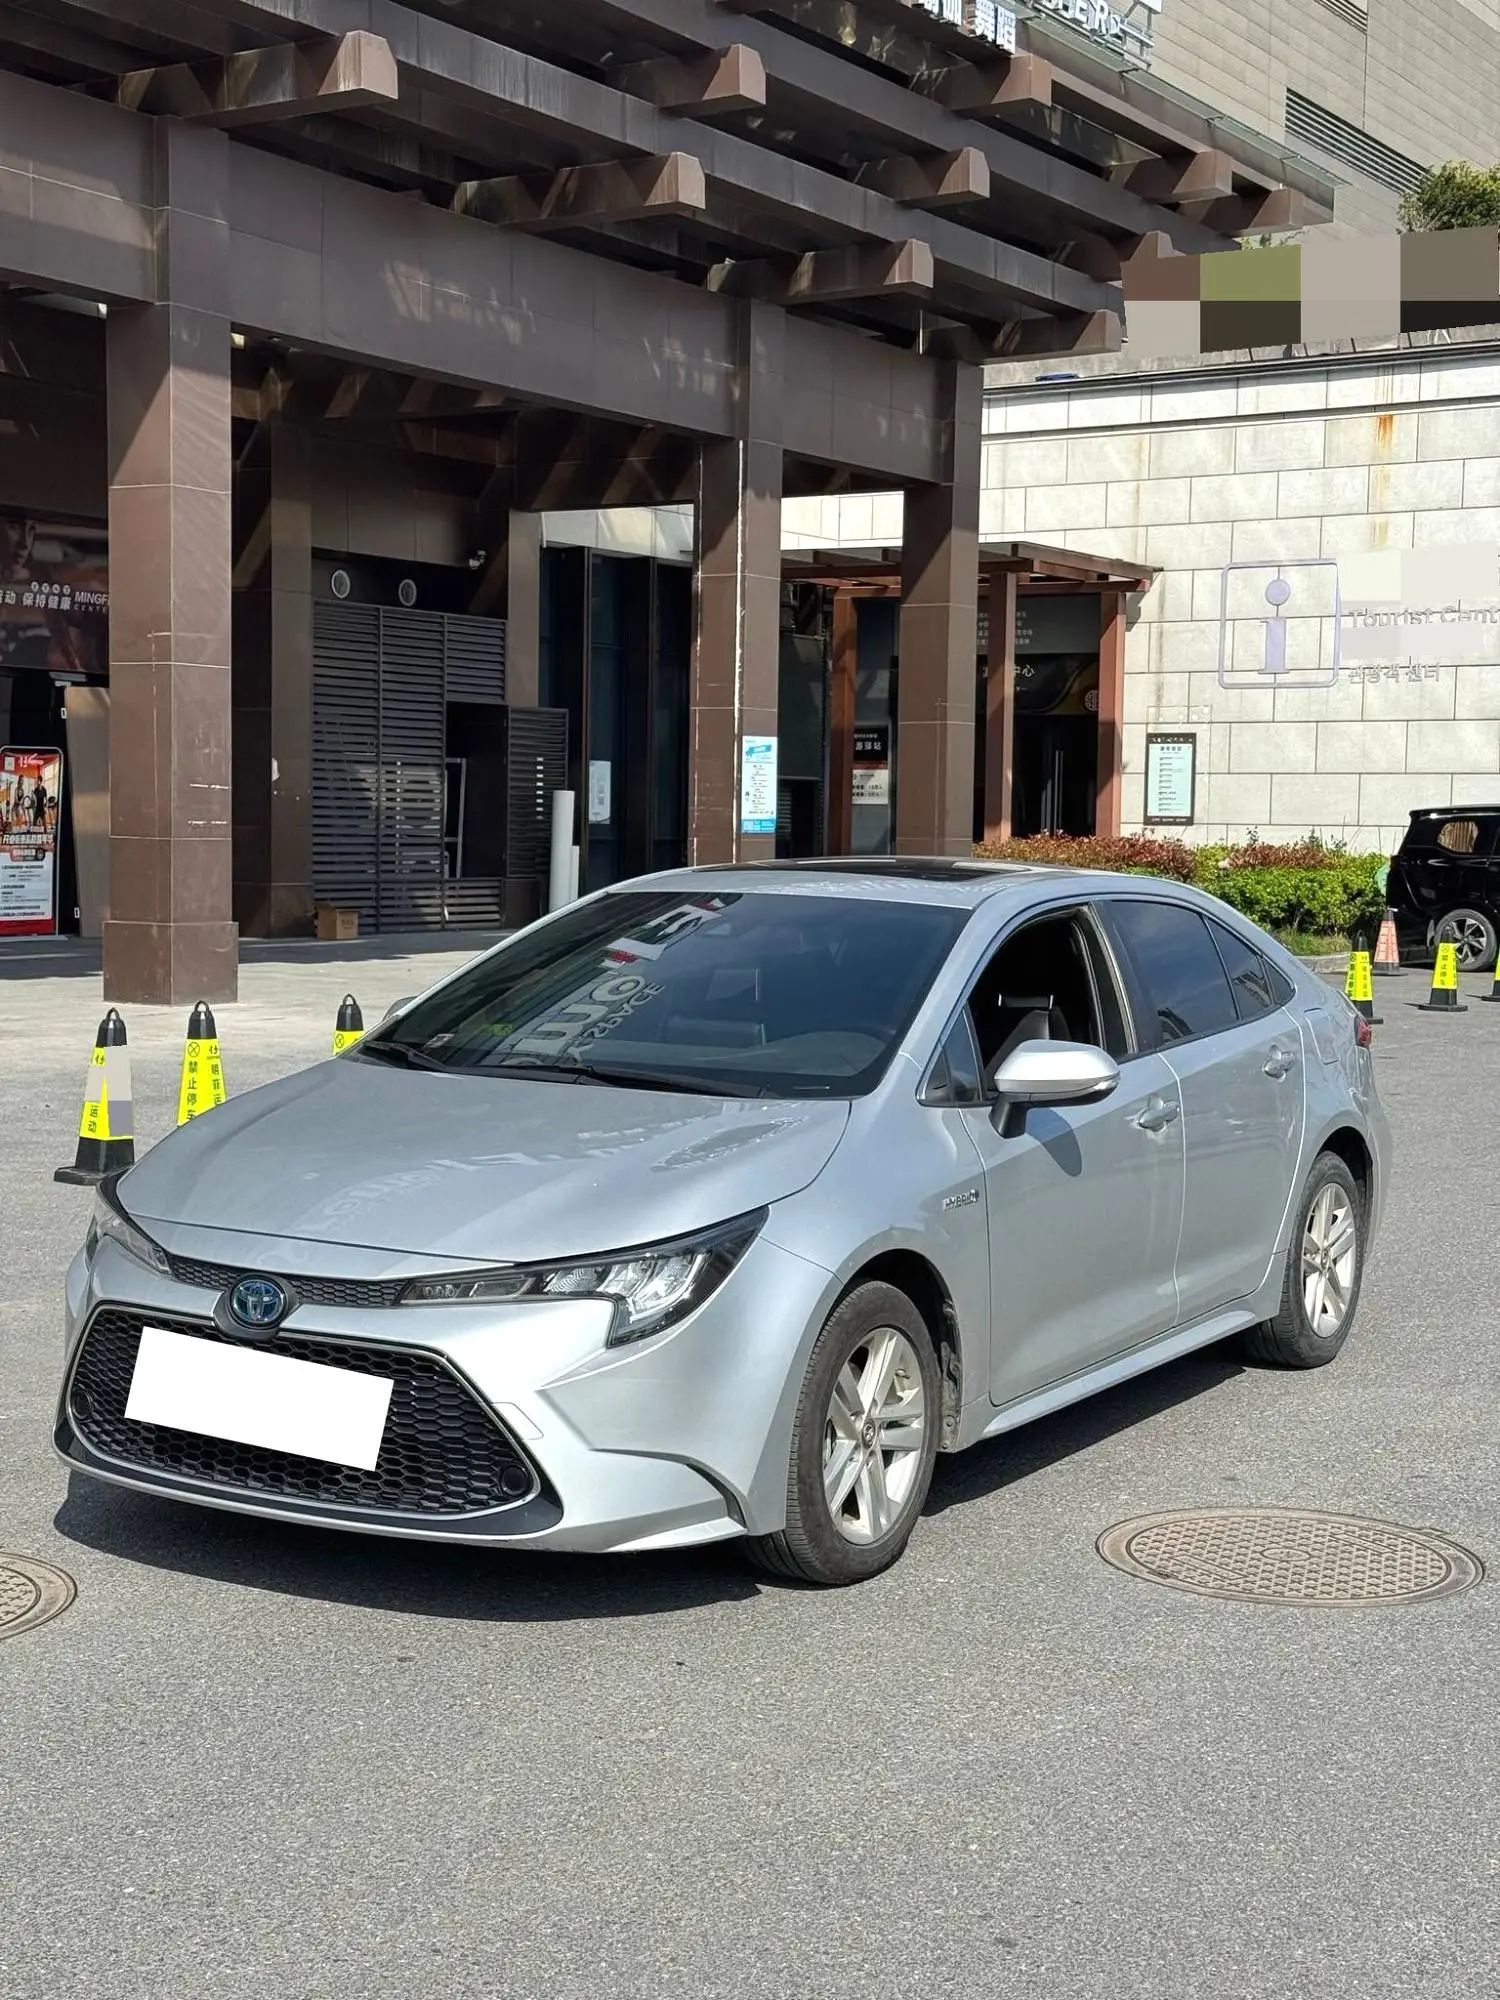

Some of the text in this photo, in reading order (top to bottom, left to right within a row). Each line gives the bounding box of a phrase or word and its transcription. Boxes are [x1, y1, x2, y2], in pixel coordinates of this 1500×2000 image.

[0, 589, 71, 610] 动 保持健康
[75, 591, 109, 605] MINGF
[1348, 605, 1500, 628] Tourist Cent
[186, 1060, 198, 1120] 禁止停车
